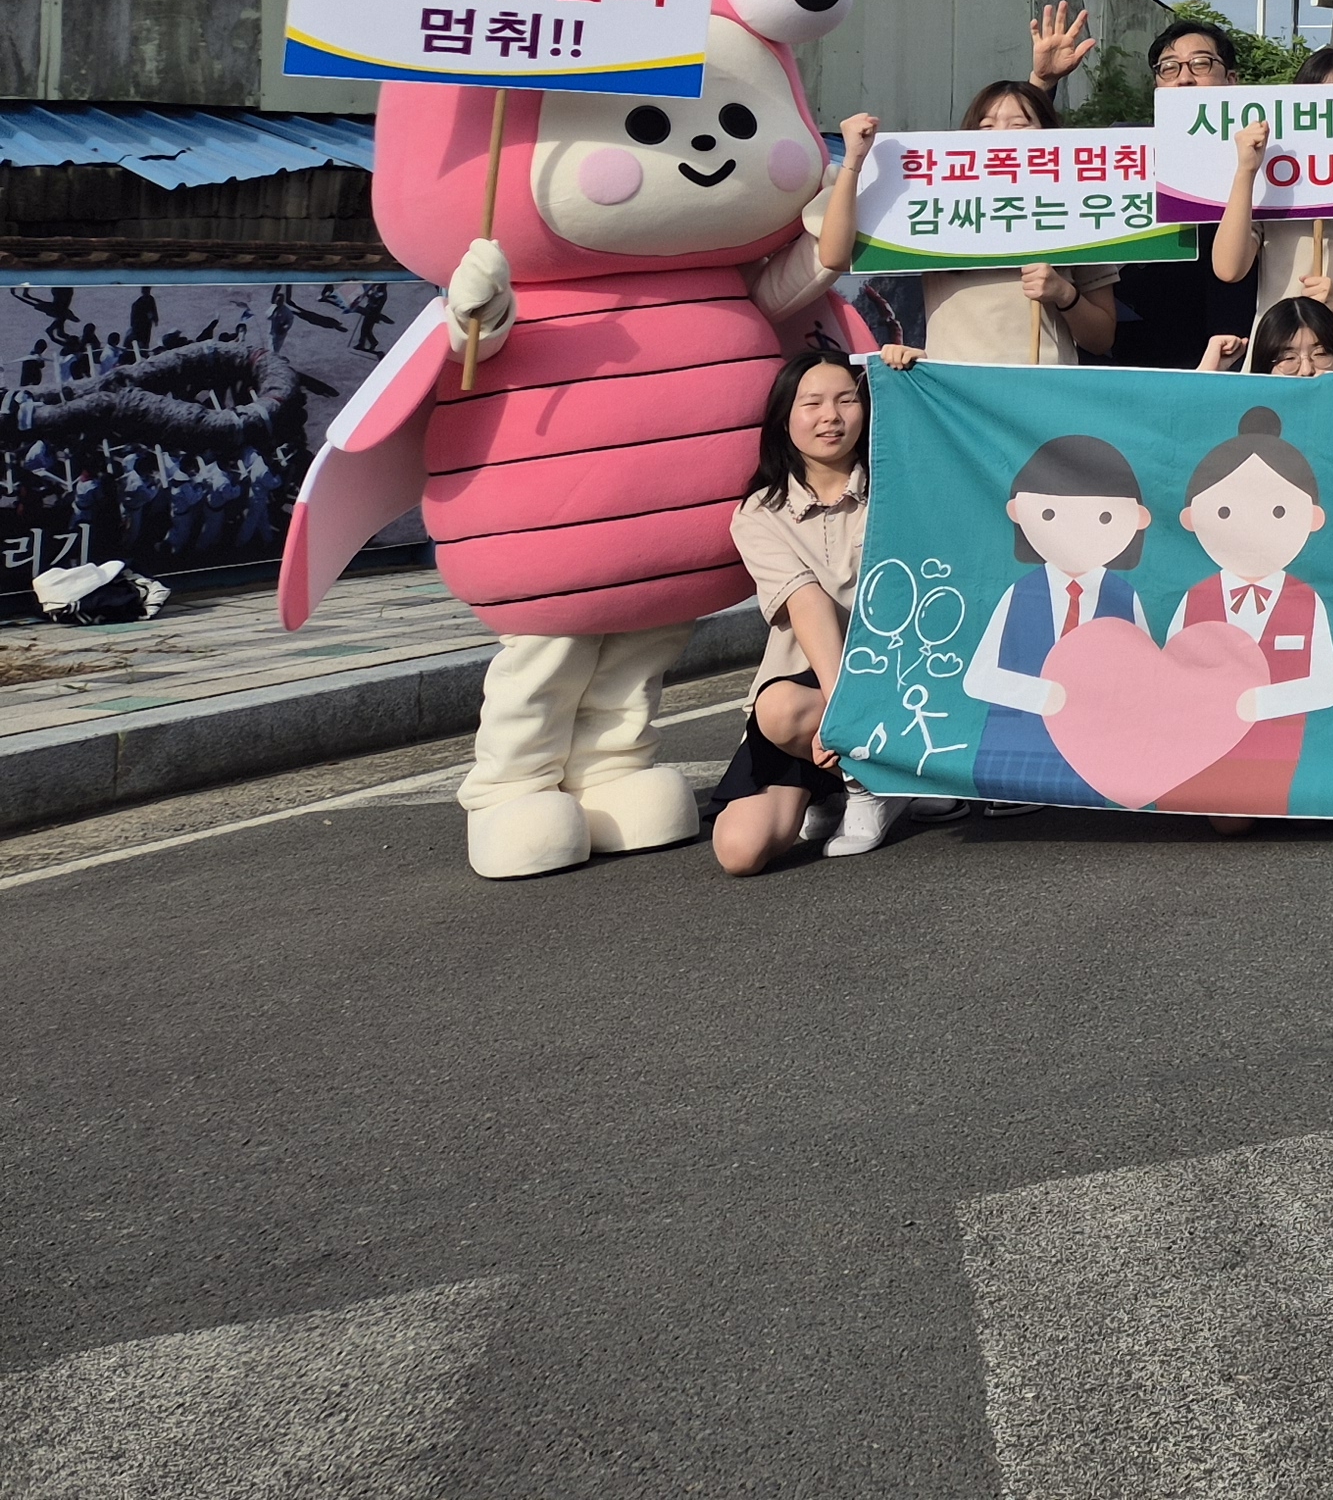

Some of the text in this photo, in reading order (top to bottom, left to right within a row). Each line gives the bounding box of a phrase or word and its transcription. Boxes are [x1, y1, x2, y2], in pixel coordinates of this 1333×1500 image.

[420, 7, 584, 59] 멈춰!!
[1187, 99, 1333, 141] 사이버
[900, 146, 1060, 186] 학교폭력
[907, 192, 1154, 235] 감싸주는 우정
